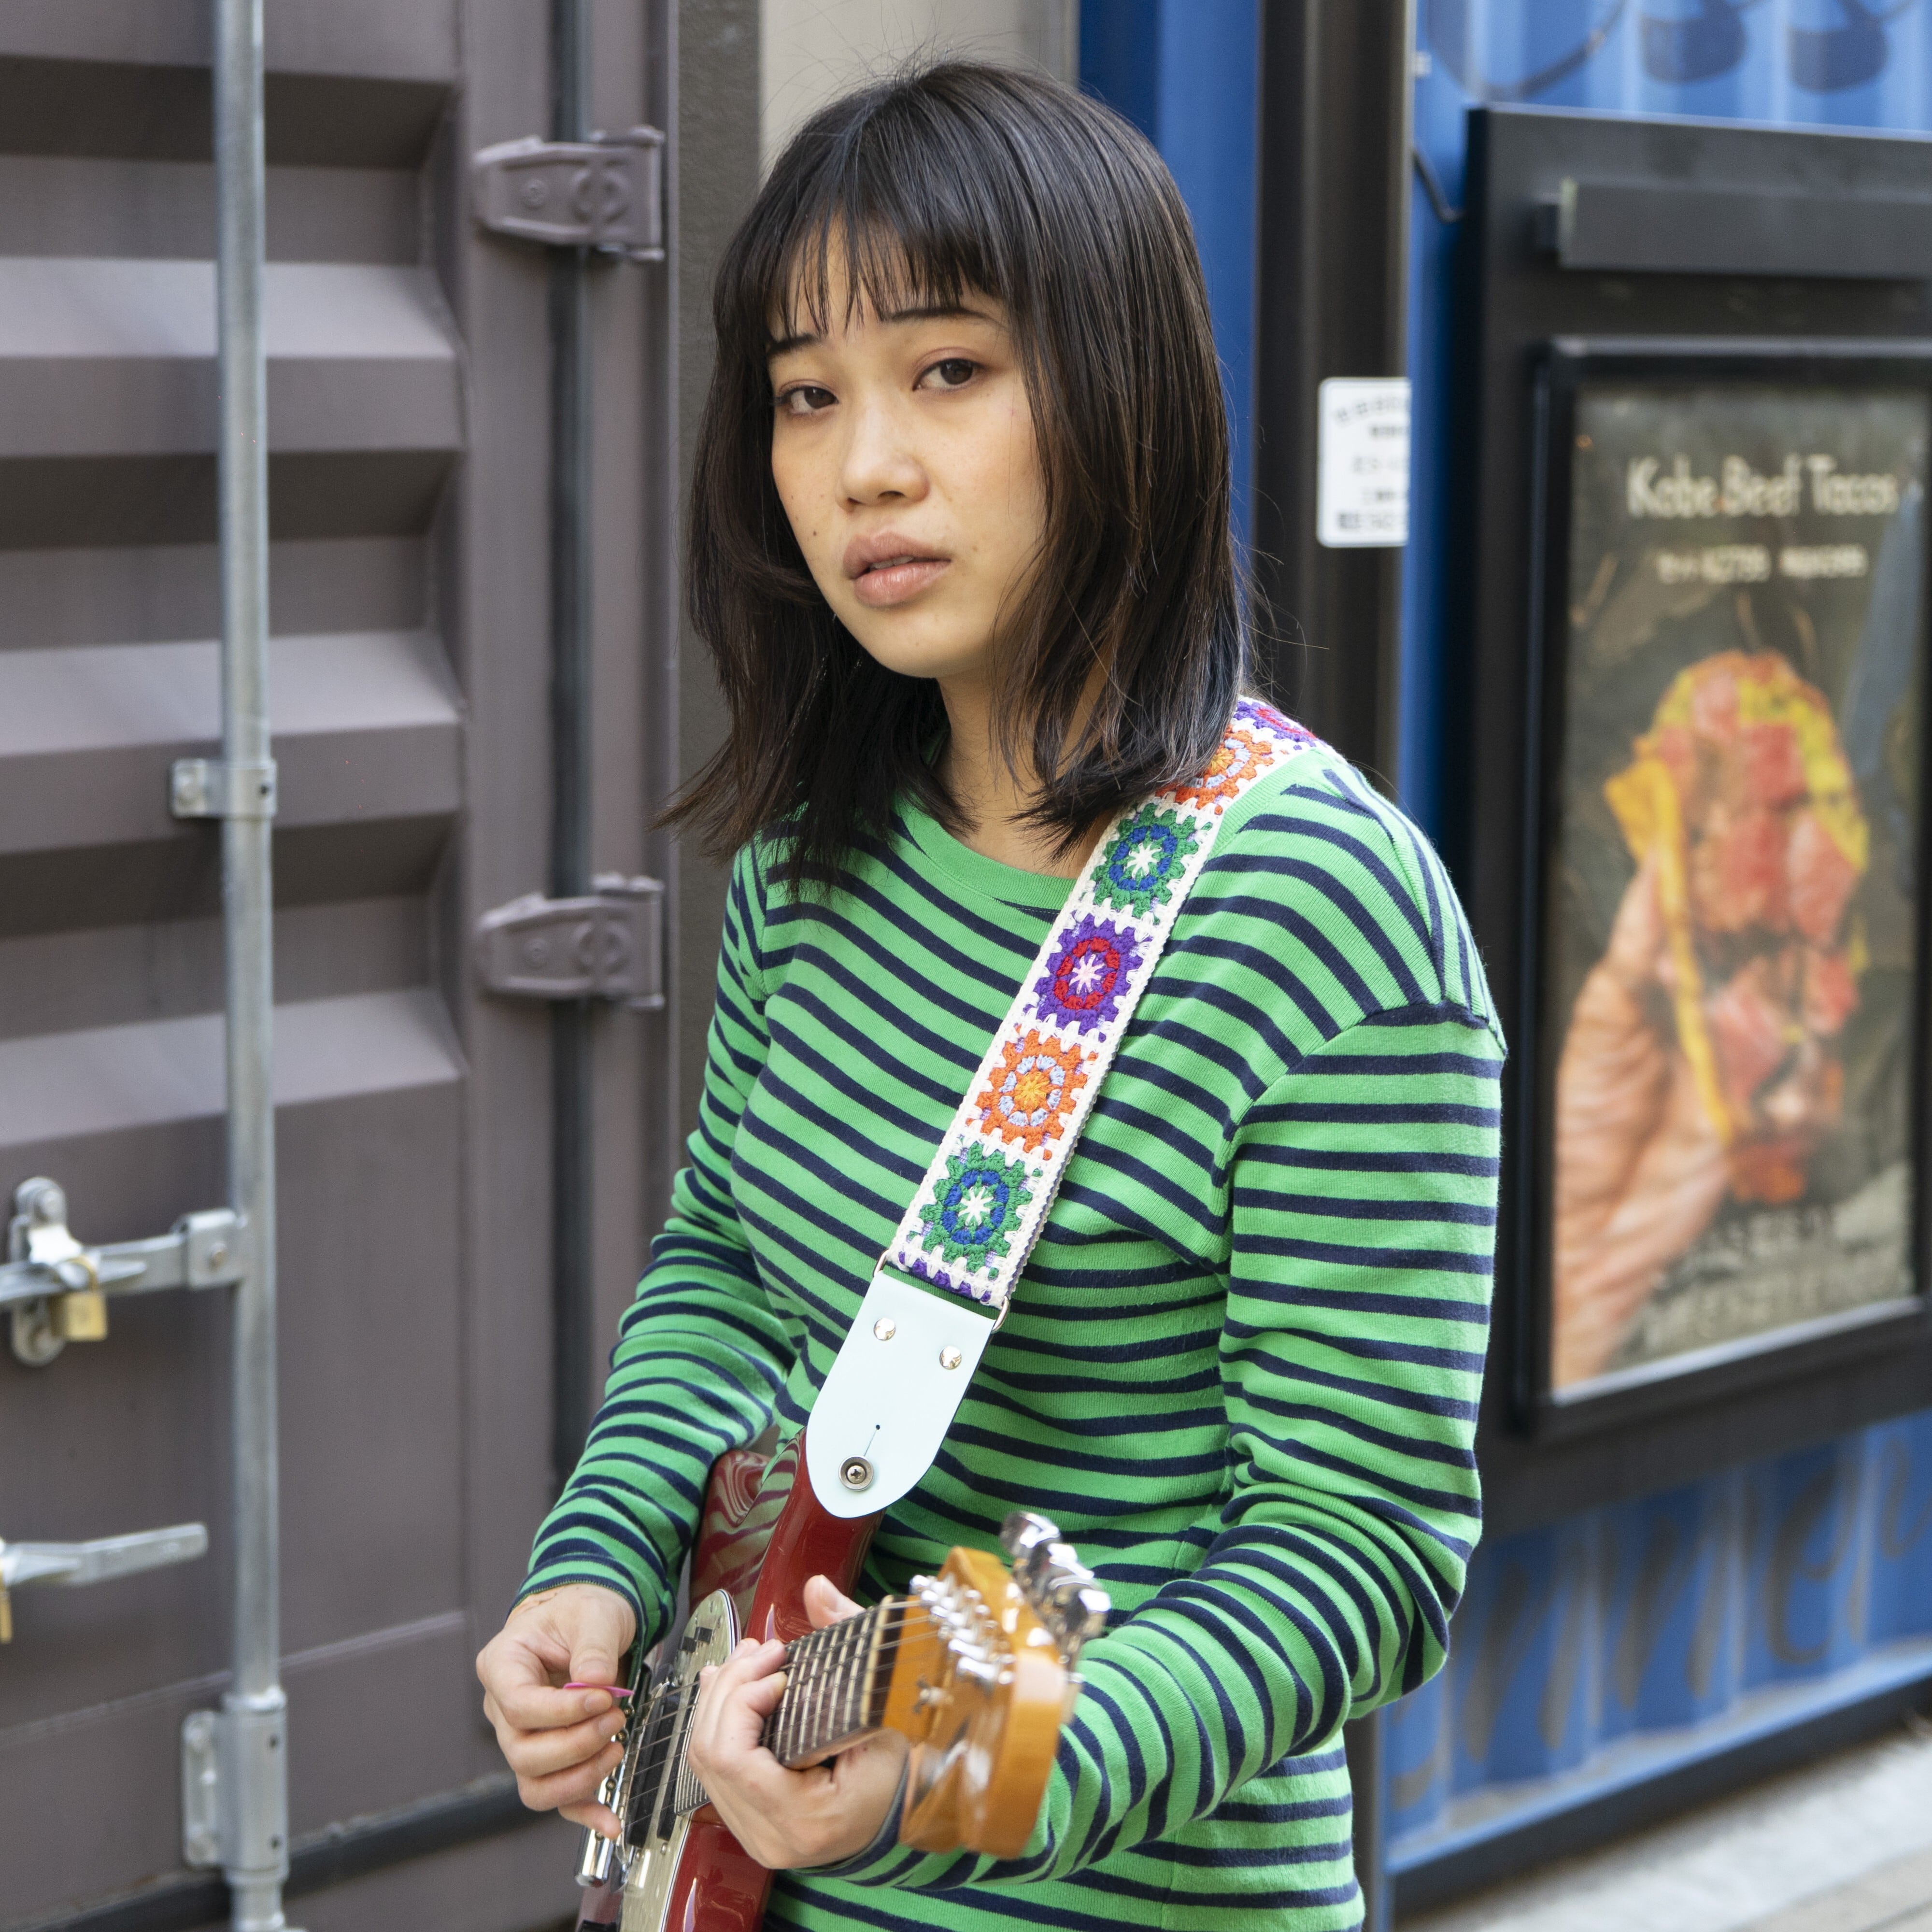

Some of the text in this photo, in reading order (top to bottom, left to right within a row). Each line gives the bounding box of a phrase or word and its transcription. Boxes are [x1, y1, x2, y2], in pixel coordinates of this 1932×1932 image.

[1628, 453, 1898, 517] Kobe Beef Tacos
